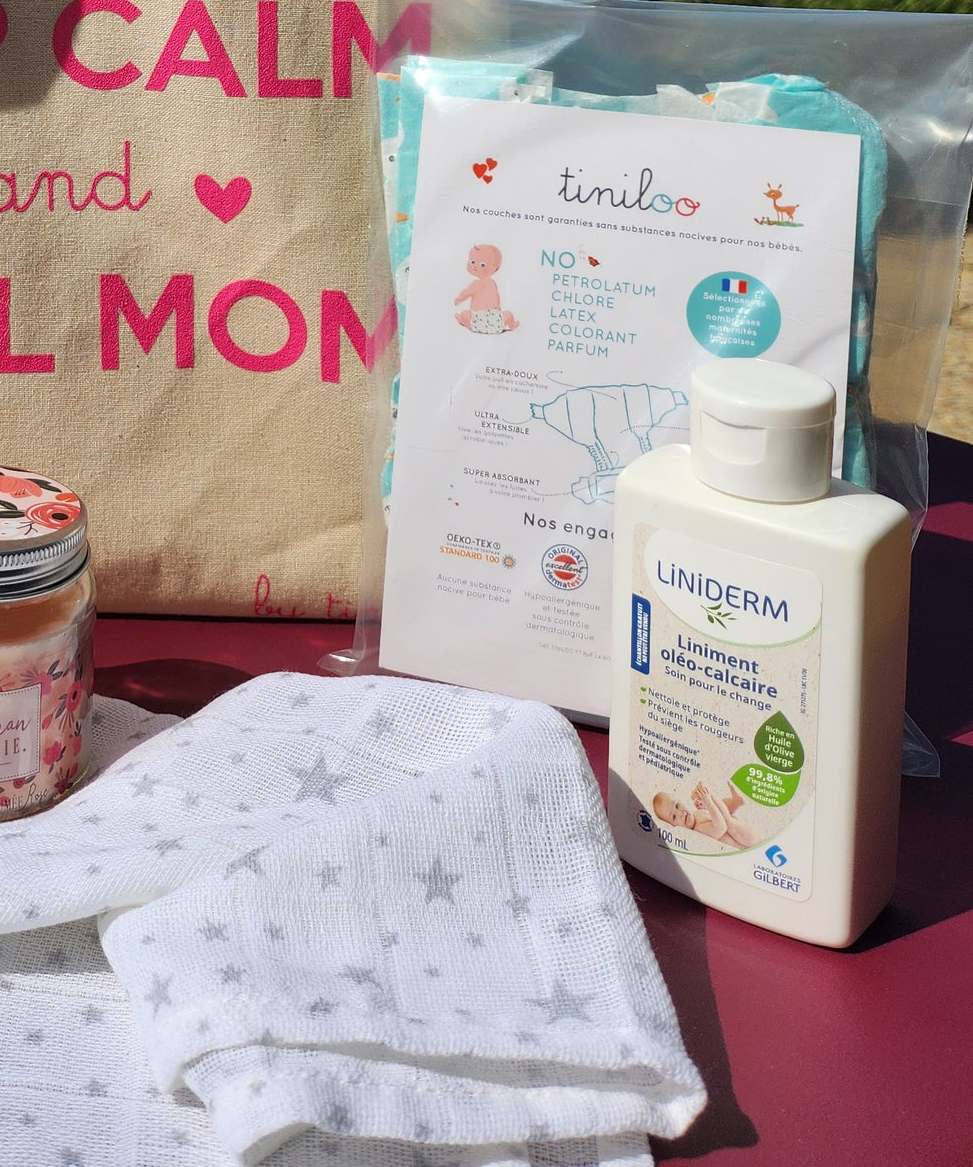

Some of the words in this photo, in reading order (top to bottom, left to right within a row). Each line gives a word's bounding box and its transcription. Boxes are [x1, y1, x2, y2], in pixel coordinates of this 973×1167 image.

[557, 166, 701, 217] tiniloo
[462, 204, 481, 214] Nos
[483, 207, 522, 220] couches
[524, 212, 544, 222] sont
[547, 215, 593, 229] garanties
[595, 221, 618, 231] sans
[620, 223, 676, 238] substances
[678, 231, 717, 243] nocives
[720, 236, 744, 246] pour
[747, 239, 765, 249] nos
[768, 241, 803, 253] bébés.
[540, 249, 576, 270] NO
[551, 273, 657, 298] PETROLATUM
[551, 289, 615, 310] CHLORE
[549, 306, 597, 324] LATEX
[548, 322, 638, 345] COLORANT
[546, 338, 610, 358] PARFUM
[485, 366, 539, 380] EXTRA-DOUX
[474, 410, 500, 421] ULTRA
[481, 421, 531, 435] EXTENSIBLE
[463, 467, 490, 478] SUPER
[492, 472, 541, 487] ABSORBANT
[523, 511, 557, 530] Nos
[439, 545, 483, 561] STANDARD
[485, 553, 500, 564] 100
[547, 546, 584, 564] ORIGINAL
[545, 561, 588, 574] excellent
[437, 573, 467, 586] Aucune
[469, 579, 513, 595] substance
[437, 584, 464, 595] nocive
[466, 590, 486, 601] pour
[488, 593, 511, 604] bébé
[524, 591, 601, 612] Hypoallergénique
[542, 604, 551, 612] et
[553, 605, 580, 618] testée
[532, 613, 552, 623] sous
[553, 615, 590, 630] contrôle
[526, 622, 595, 642] dermatologique
[677, 633, 760, 676] Liniment
[660, 647, 779, 700] oléo-calcaire
[664, 665, 688, 682] Soin
[689, 675, 715, 694] pour
[717, 684, 727, 697] le
[729, 688, 773, 712] change
[648, 687, 680, 707] Nettoie
[681, 703, 691, 713] et
[692, 708, 730, 726] protège
[647, 711, 659, 722] du
[660, 716, 684, 733] siège
[648, 699, 684, 722] Prévient
[685, 715, 698, 727] les
[700, 723, 745, 745] rougeurs
[765, 725, 785, 736] Riche
[764, 743, 795, 758] d'Olive
[768, 734, 792, 748] Huile
[638, 744, 691, 774] dermatologique
[639, 734, 656, 748] Testé
[656, 744, 671, 756] sous
[672, 752, 701, 769] contrôle
[765, 753, 794, 768] vierge
[638, 753, 646, 762] et
[645, 756, 684, 779] pédiatrique
[748, 767, 783, 786] 99,8%
[752, 785, 779, 798] d'origine
[752, 792, 780, 806] naturelle
[658, 828, 673, 844] 100
[674, 837, 689, 851] mL
[753, 863, 802, 884] LABORATOIRES
